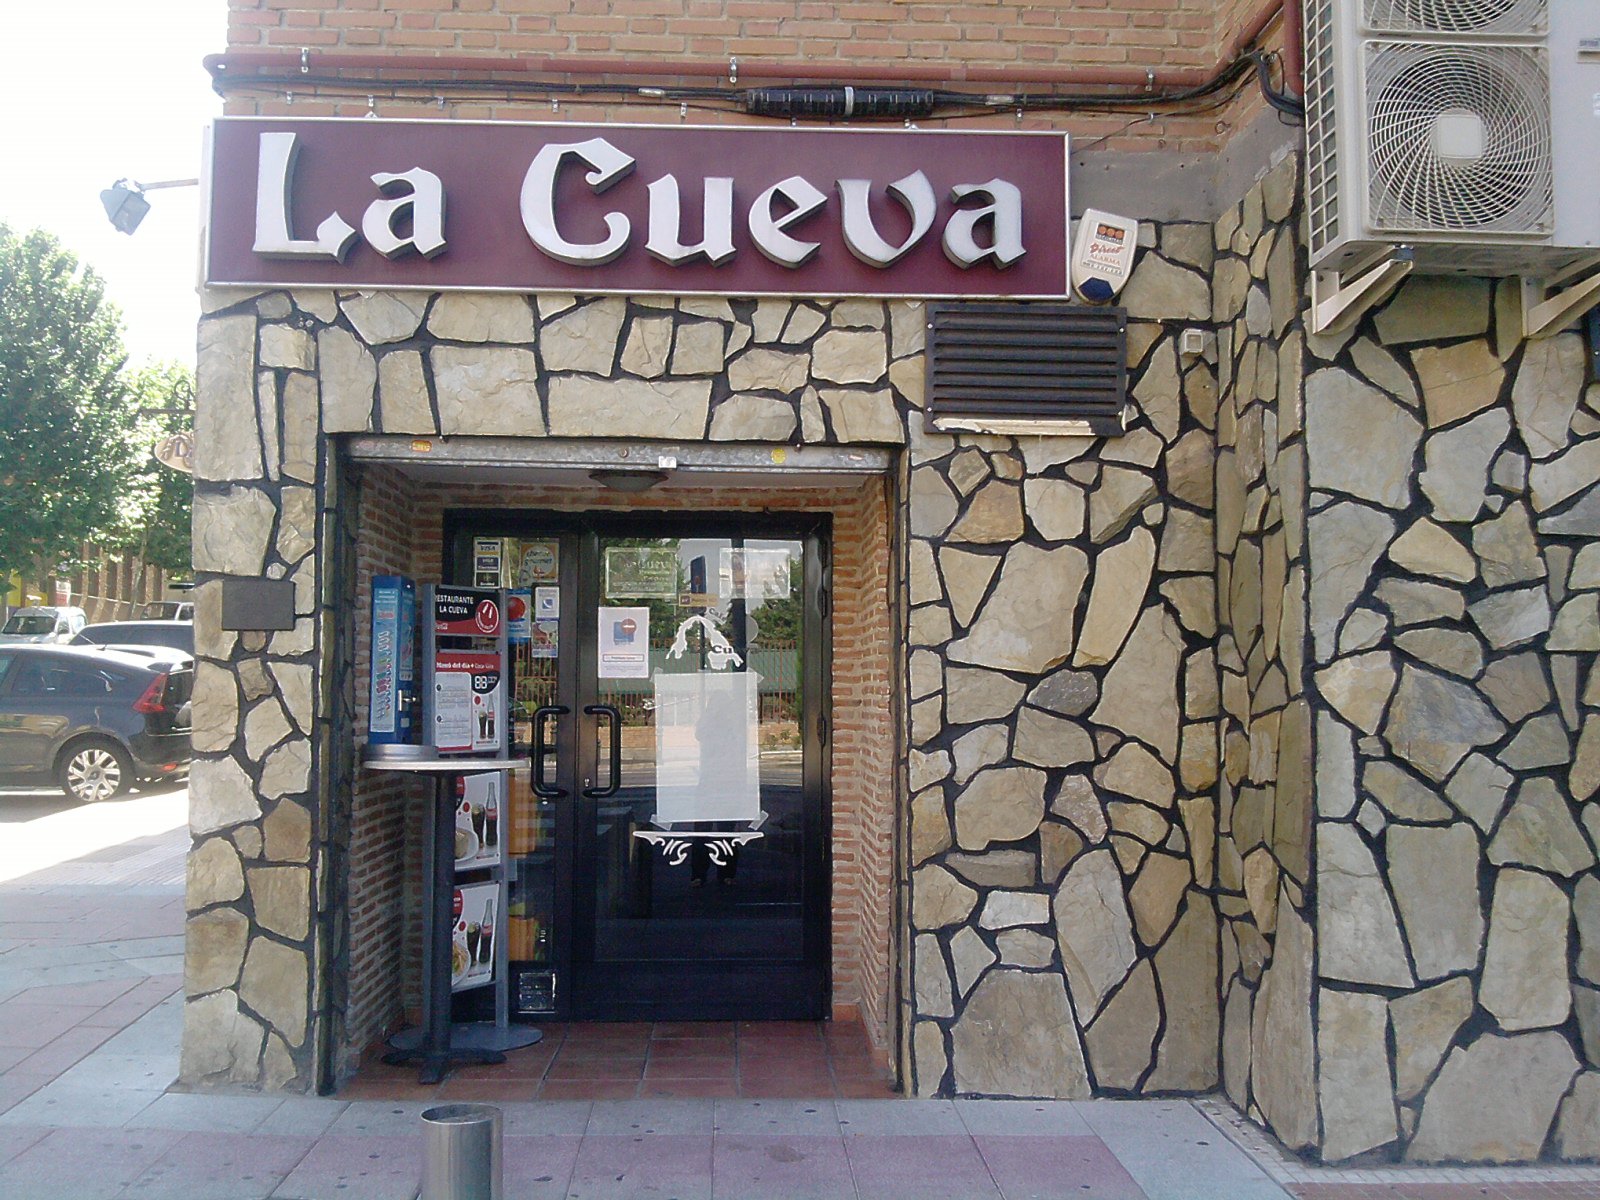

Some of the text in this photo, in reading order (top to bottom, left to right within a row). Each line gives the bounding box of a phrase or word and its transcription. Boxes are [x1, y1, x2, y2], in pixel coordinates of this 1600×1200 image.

[252, 131, 1028, 269] La Cueva
[439, 605, 468, 614] LA CUEVA
